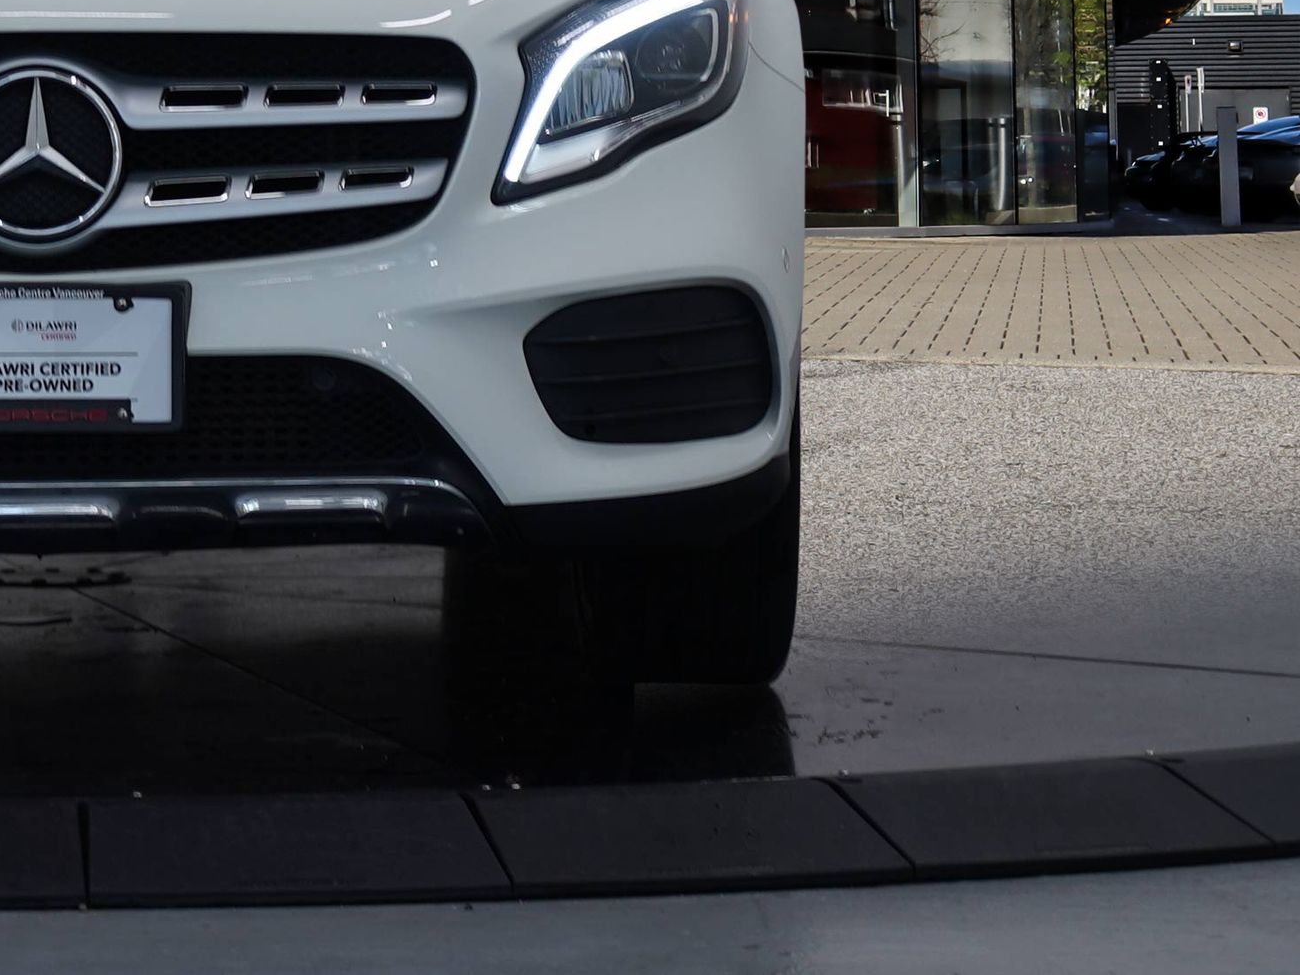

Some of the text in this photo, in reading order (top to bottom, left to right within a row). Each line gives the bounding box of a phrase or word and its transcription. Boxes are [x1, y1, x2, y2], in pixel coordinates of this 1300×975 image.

[18, 287, 51, 299] Centre
[52, 287, 105, 300] Vancouver
[25, 320, 77, 332] DILAWRI
[39, 362, 122, 377] CERTIFIED
